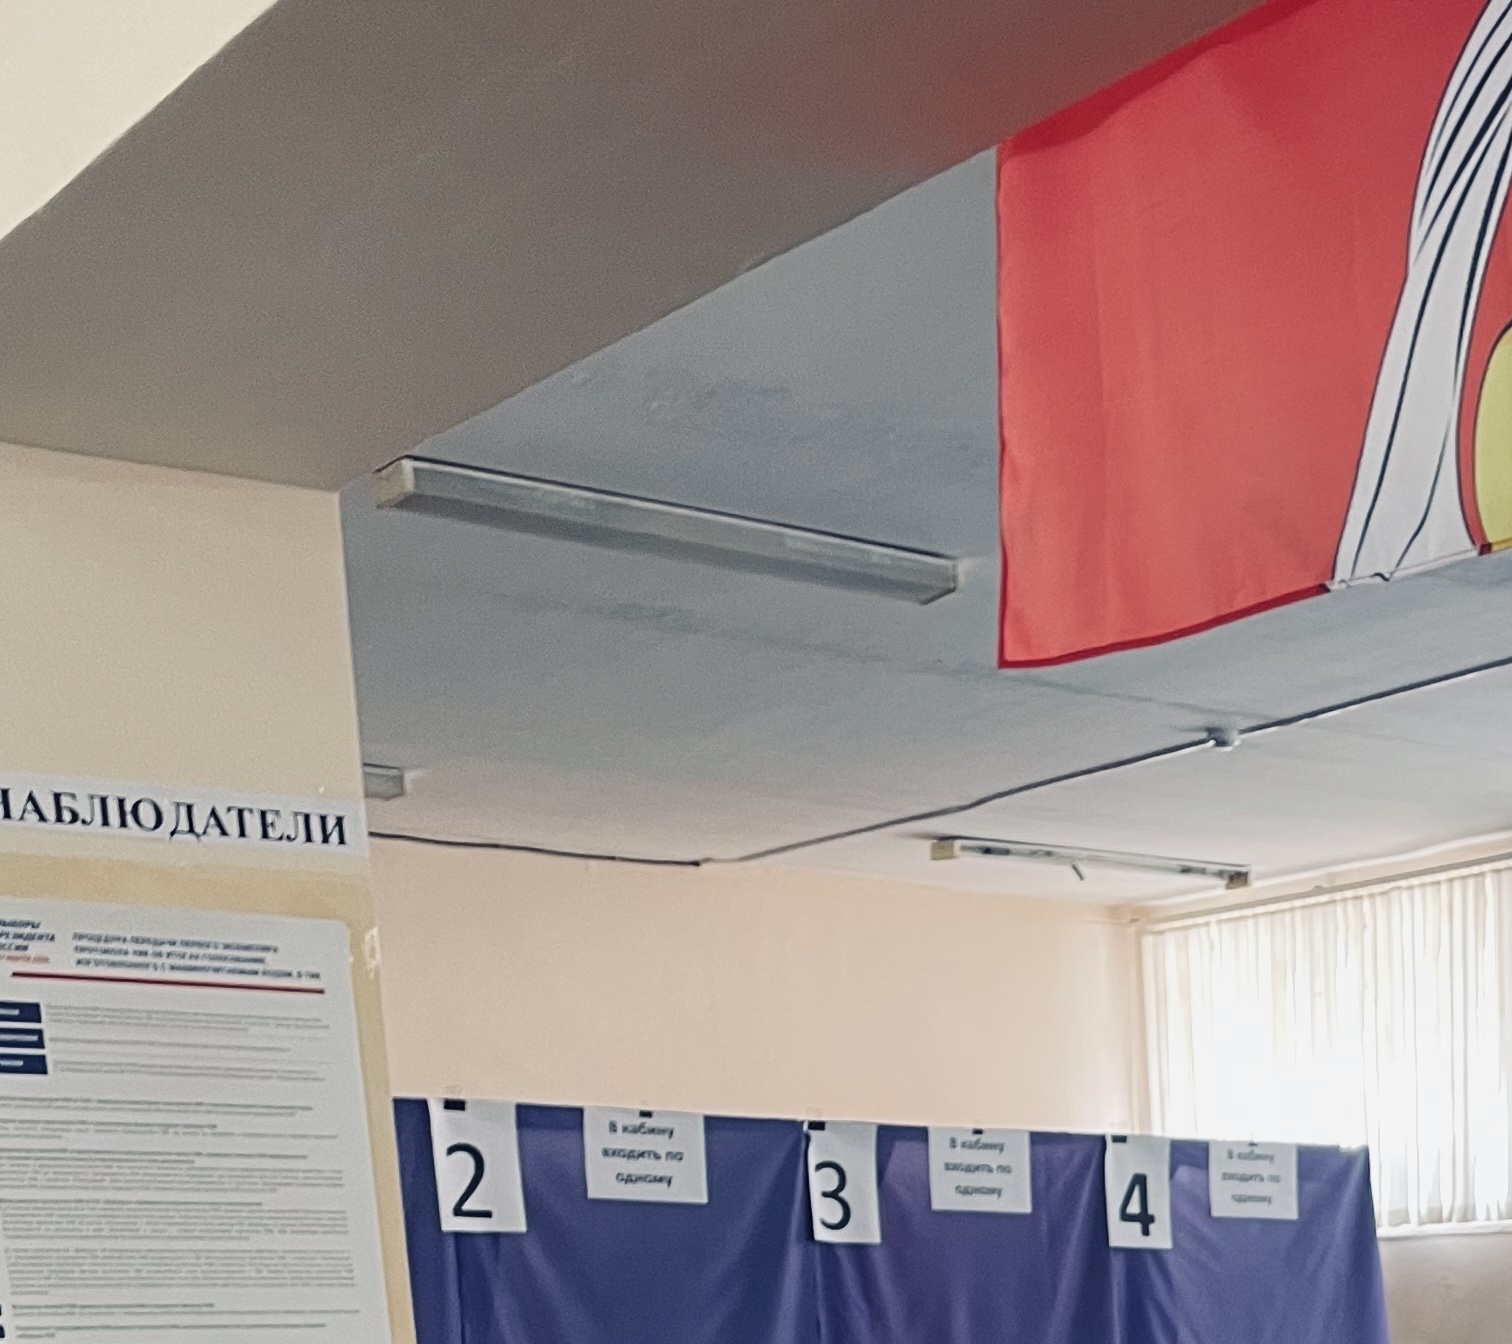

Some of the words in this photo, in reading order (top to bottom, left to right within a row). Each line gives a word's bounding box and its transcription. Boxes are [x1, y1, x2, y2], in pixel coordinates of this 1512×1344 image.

[608, 1120, 618, 1134] В
[622, 1121, 674, 1140] кабину
[601, 1147, 662, 1161] входить
[665, 1151, 684, 1161] по
[446, 1142, 493, 1219] 2
[615, 1172, 673, 1189] одному
[814, 1159, 851, 1230] 3
[1119, 1172, 1155, 1237] 4
